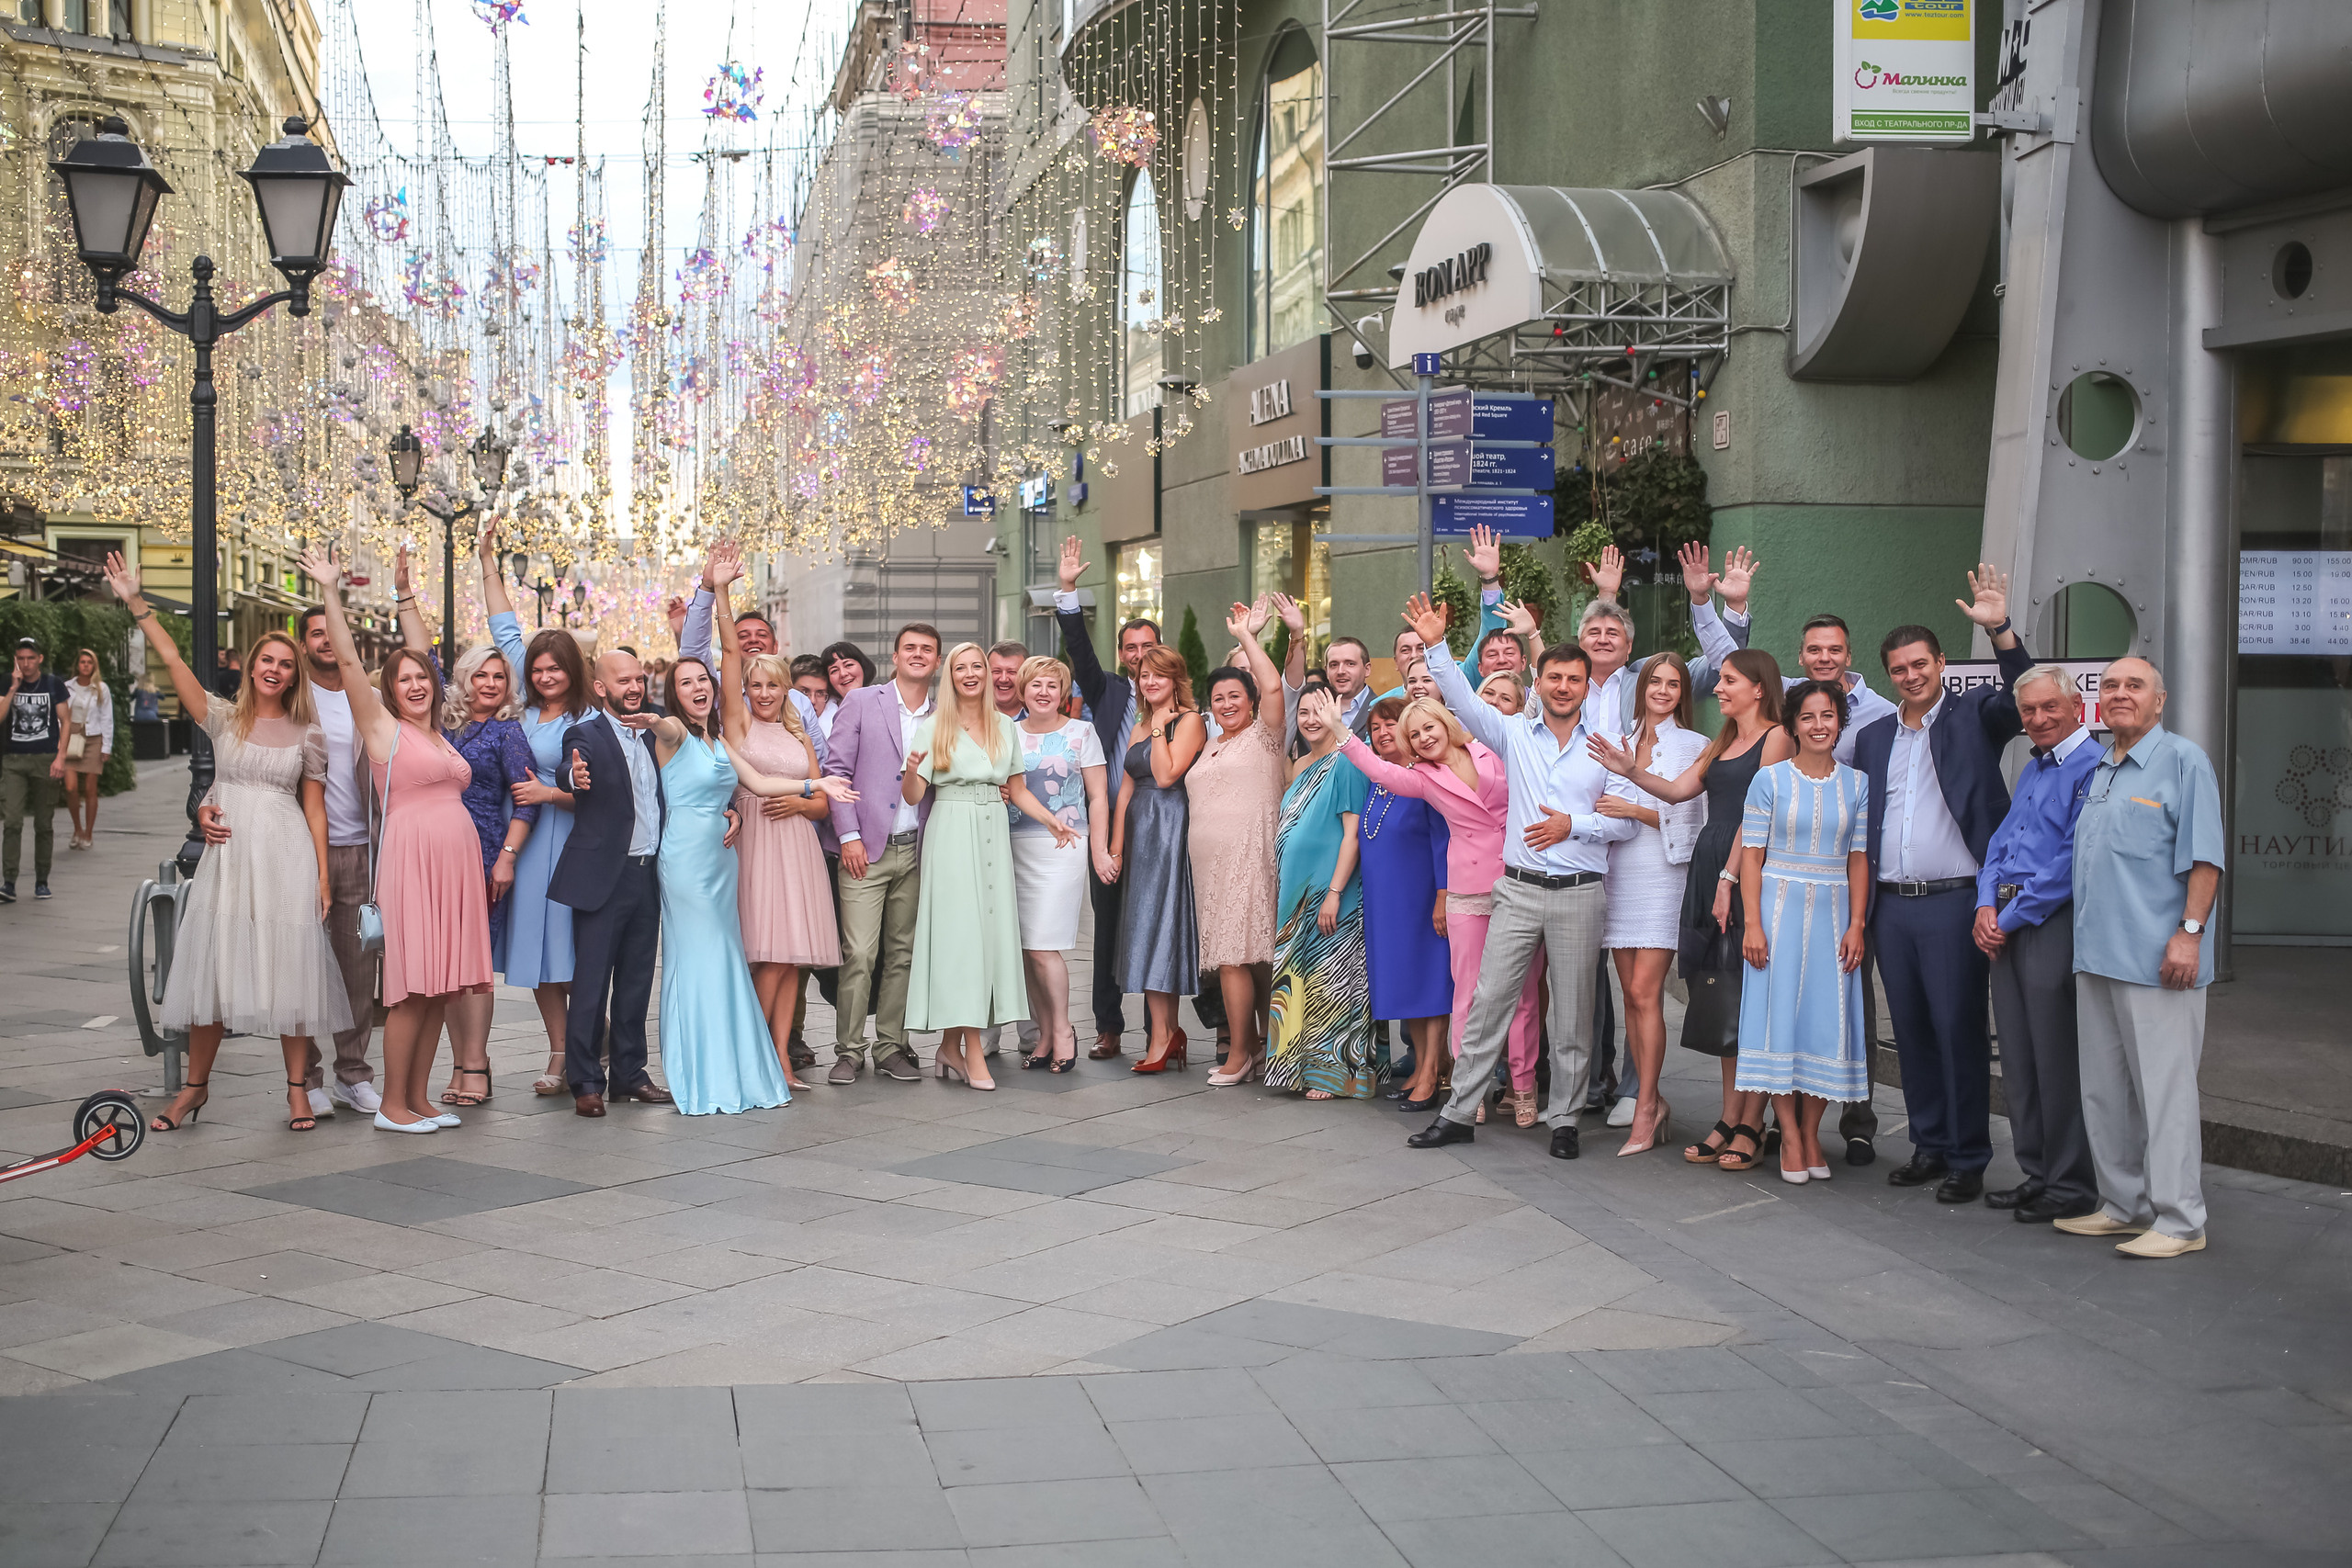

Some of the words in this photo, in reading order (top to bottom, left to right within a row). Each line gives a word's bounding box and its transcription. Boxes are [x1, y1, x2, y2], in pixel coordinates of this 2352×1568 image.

[1883, 73, 1967, 86] Малинка
[1854, 119, 1874, 128] ВХОД
[1884, 119, 1942, 128] ТЕАТРАЛЬНОГО
[1944, 120, 1968, 129] ПР-ДА
[1414, 258, 1453, 308] BON
[1454, 243, 1492, 291] APP
[1250, 378, 1290, 426] ALENA
[1623, 435, 1652, 457] cafe
[1485, 453, 1506, 461] театр,
[2240, 835, 2352, 855] НАУТИ
[2263, 861, 2330, 870] ТОРГОВЫЙ
